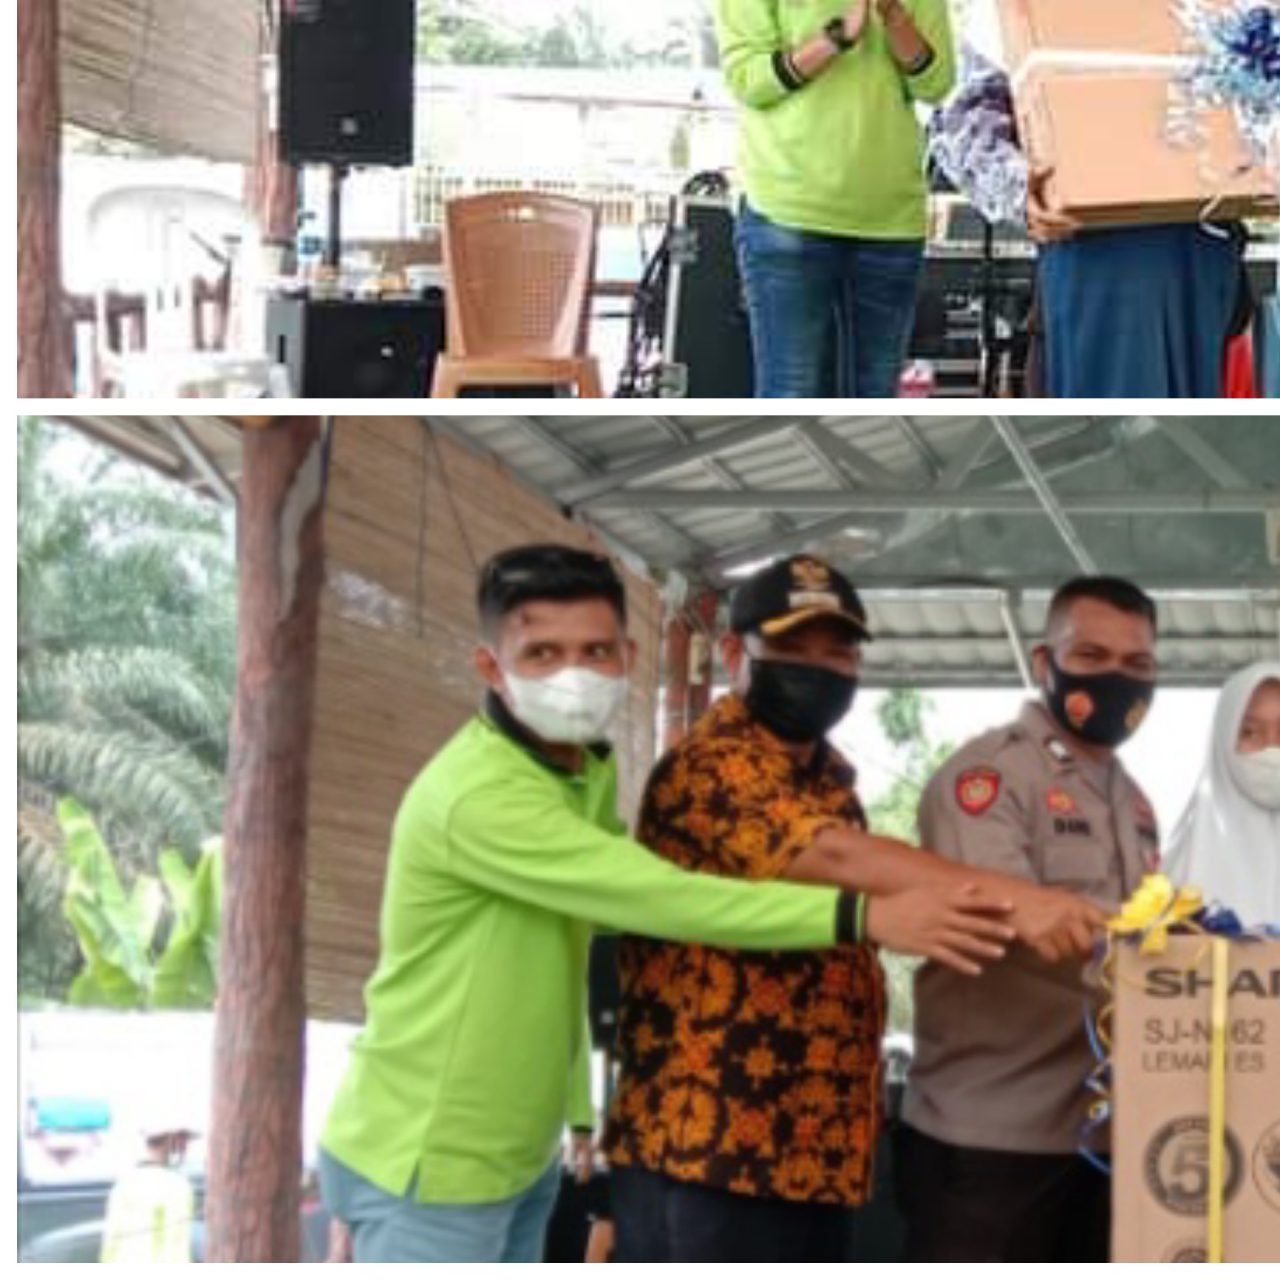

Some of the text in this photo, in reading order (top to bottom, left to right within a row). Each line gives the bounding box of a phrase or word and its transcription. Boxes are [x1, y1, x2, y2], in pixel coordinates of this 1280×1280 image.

[1145, 1019, 1265, 1044] SJ-N62
[1142, 1051, 1264, 1072] LEMA ES
